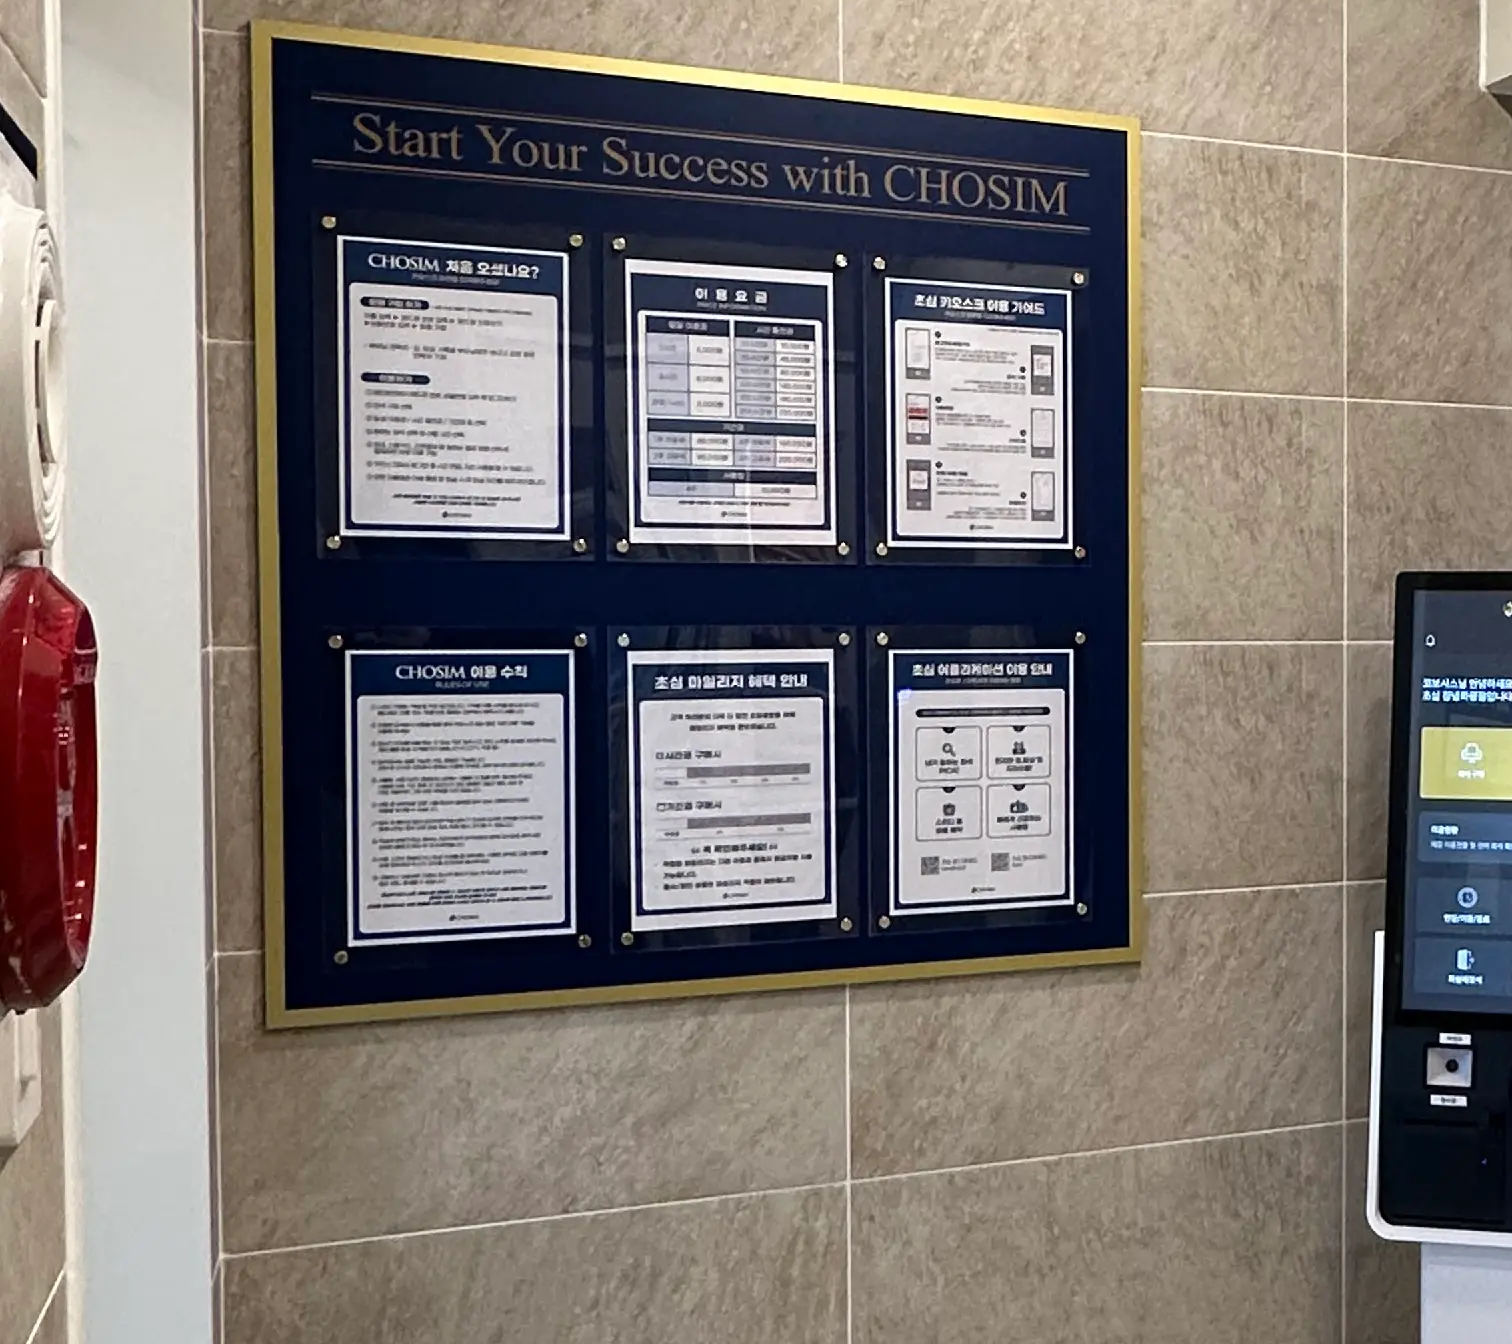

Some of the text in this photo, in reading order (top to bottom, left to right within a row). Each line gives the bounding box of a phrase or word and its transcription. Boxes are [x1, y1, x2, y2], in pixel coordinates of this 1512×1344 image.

[352, 112, 1069, 216] Start Your Success with CHOSIM
[368, 253, 440, 272] CHOSIM
[446, 260, 473, 274] 처음
[477, 262, 539, 279] 오셨나요?
[940, 295, 985, 311] 키오스크
[1012, 301, 1045, 315] 가이드
[395, 665, 465, 679] CHOSIM
[654, 674, 808, 690] 초심 마일리지 혜택 안내
